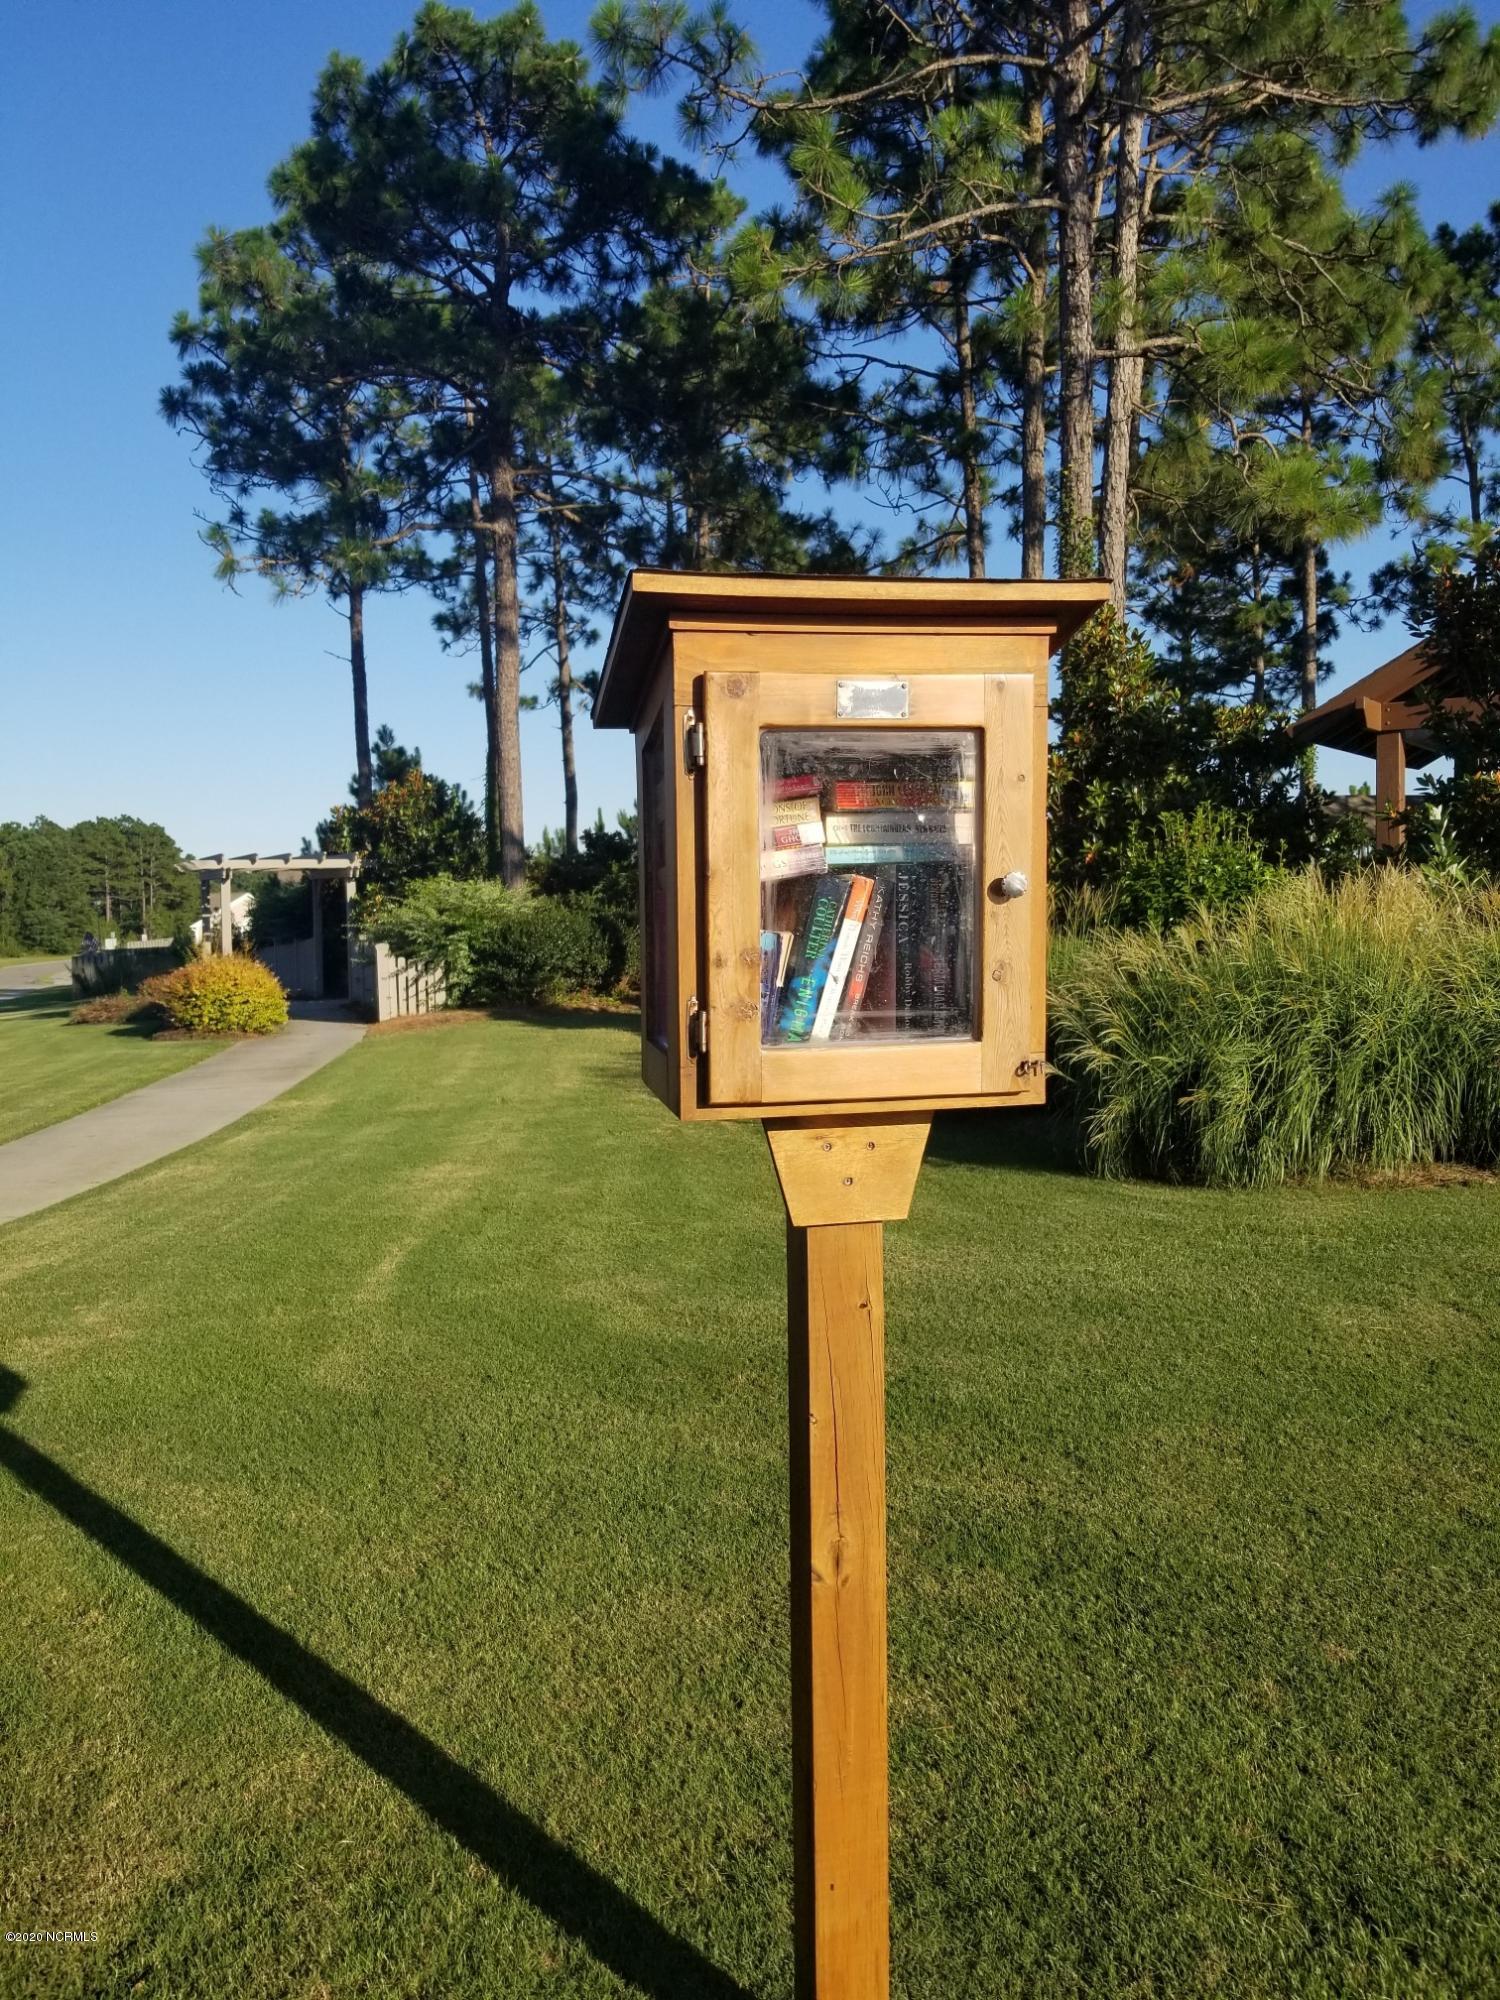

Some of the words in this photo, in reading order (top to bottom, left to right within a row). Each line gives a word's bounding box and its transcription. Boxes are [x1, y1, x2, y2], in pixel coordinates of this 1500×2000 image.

[805, 897, 828, 960] COULTER
[867, 883, 888, 932] KATHY
[897, 872, 910, 944] JESSICA
[855, 934, 875, 981] REICHS
[787, 977, 817, 1042] ENIGMA
